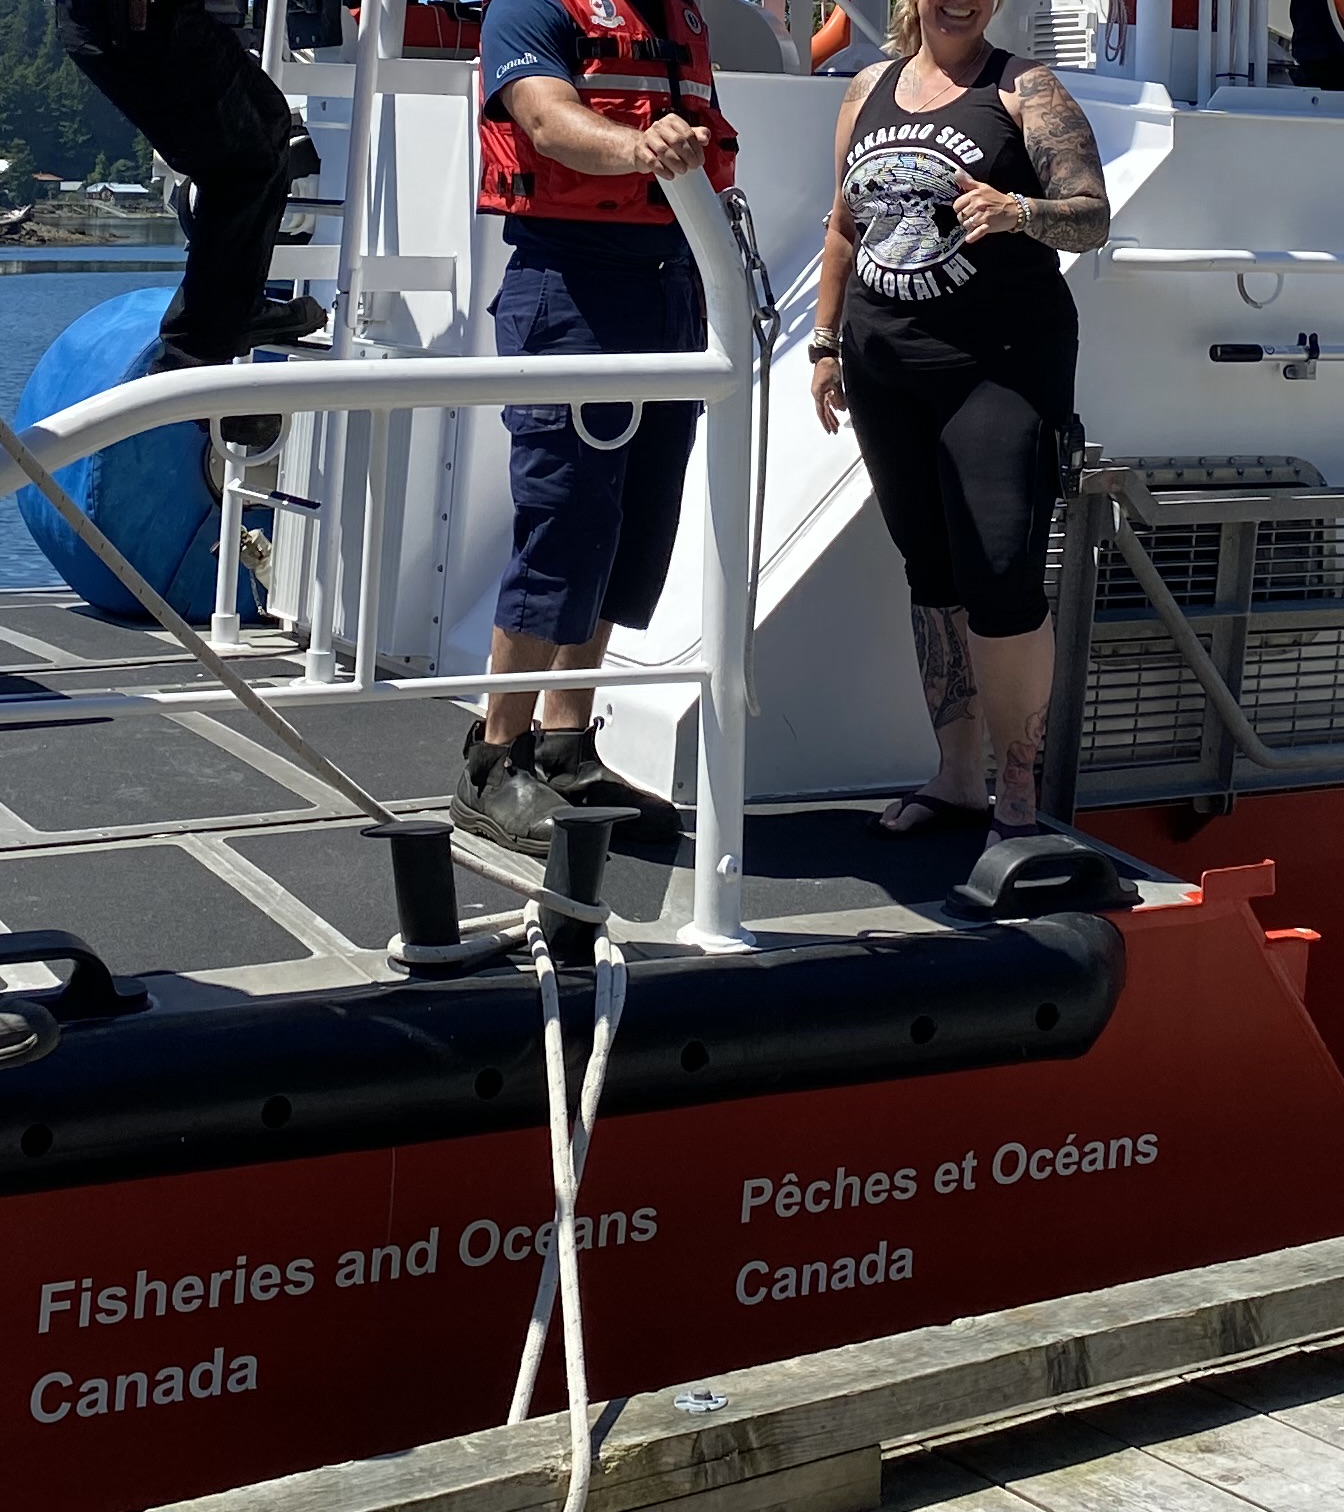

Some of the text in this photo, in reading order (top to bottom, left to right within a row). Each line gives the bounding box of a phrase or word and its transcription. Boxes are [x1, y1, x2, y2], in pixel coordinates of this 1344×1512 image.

[935, 126, 984, 165] SEED
[740, 1133, 1159, 1224] Pêches et Océans
[37, 1206, 658, 1334] Fisheries and Oceans
[735, 1240, 914, 1305] Canada
[30, 1346, 259, 1424] Canada
